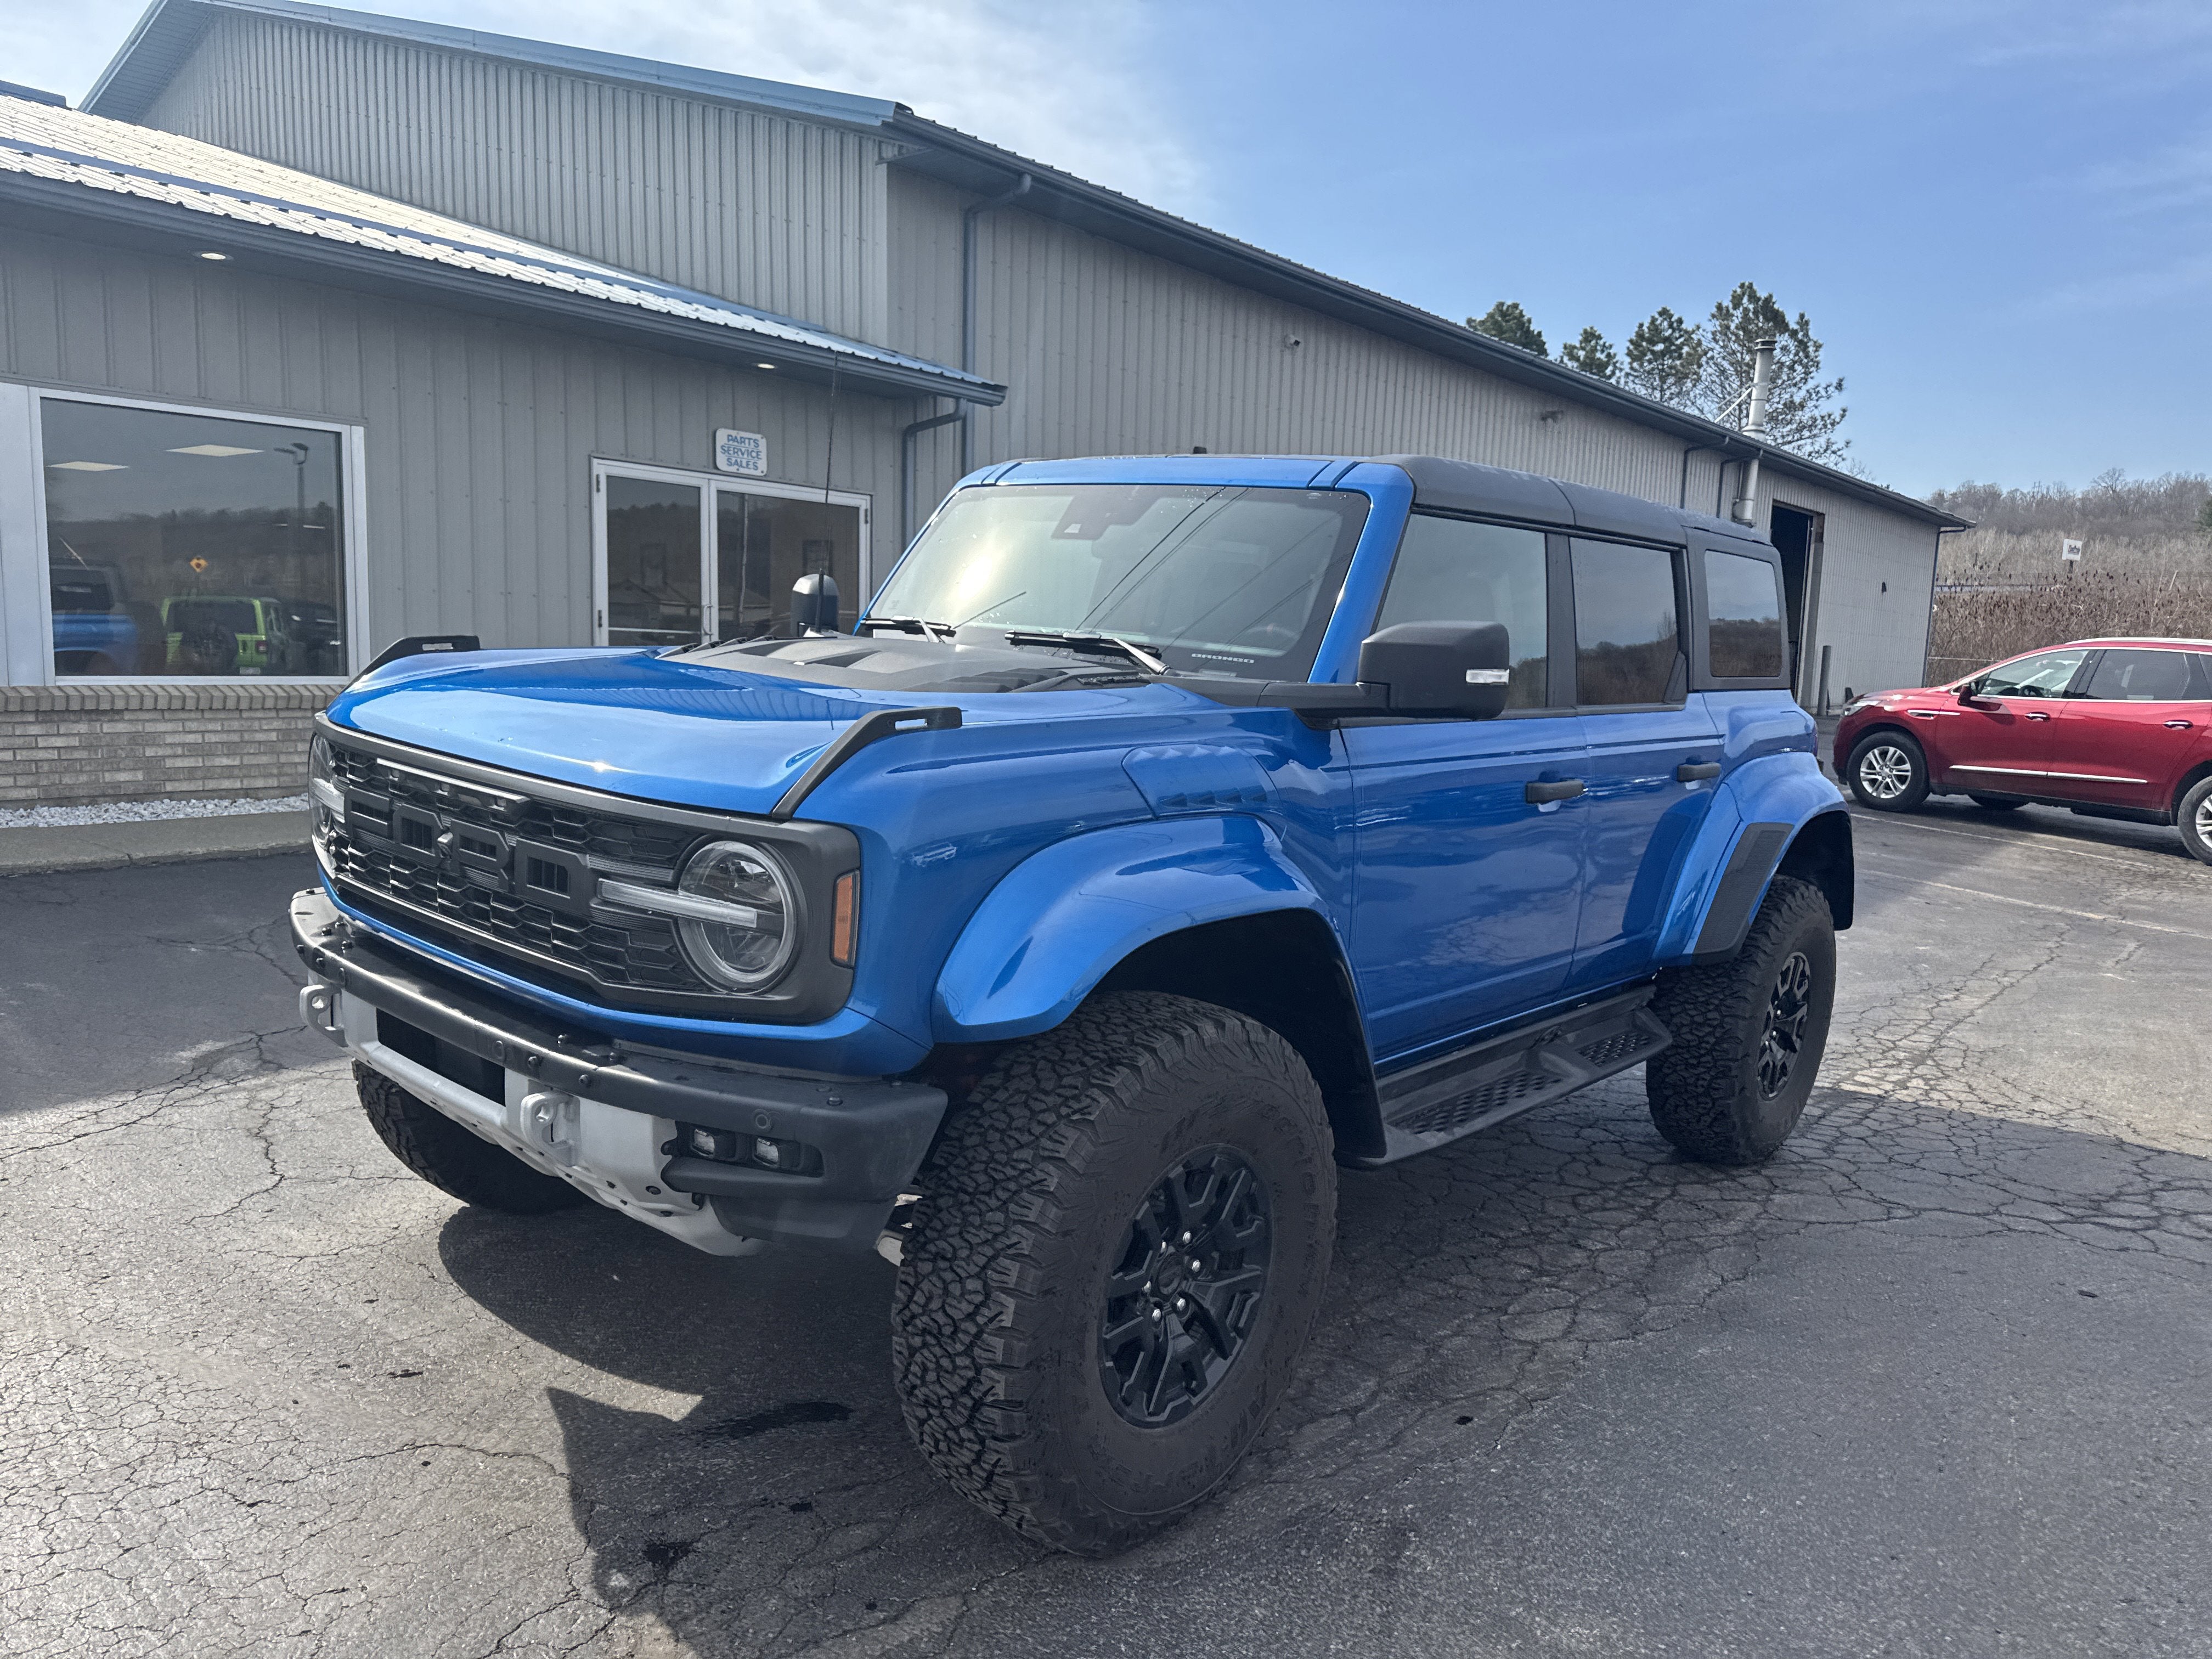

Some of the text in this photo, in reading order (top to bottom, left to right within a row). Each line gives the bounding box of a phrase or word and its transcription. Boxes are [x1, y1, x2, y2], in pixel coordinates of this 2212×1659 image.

[727, 435, 759, 448] PARTS
[721, 445, 762, 460] SERVICE
[727, 458, 758, 470] SALES
